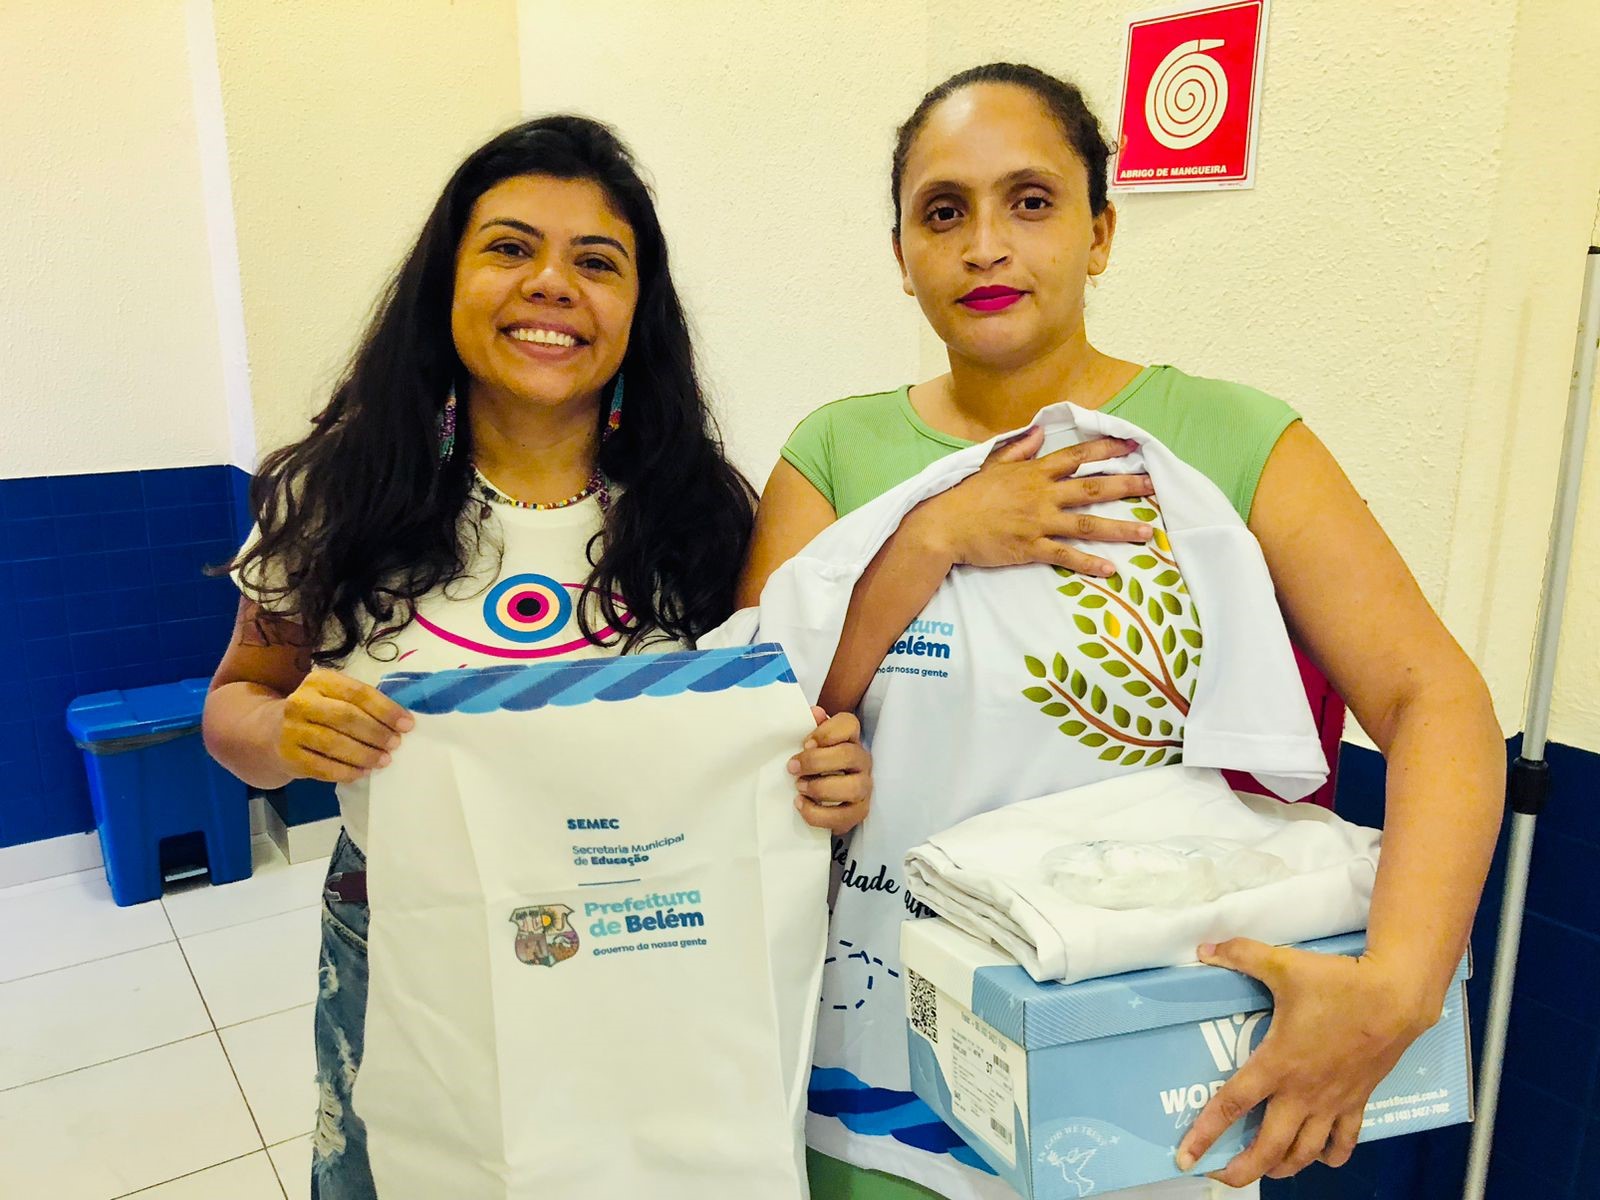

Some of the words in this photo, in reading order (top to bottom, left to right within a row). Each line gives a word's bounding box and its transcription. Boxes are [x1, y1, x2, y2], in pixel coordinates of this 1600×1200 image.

[1120, 169, 1155, 179] ABRIGO
[1156, 168, 1169, 177] DE
[1170, 165, 1228, 176] MANGUEIRA
[895, 666, 920, 675] nossa
[921, 669, 949, 679] gente
[567, 818, 620, 830] SEMEC
[572, 845, 629, 855] Secretaria
[631, 833, 685, 853] Municipal
[574, 856, 588, 866] de
[591, 853, 650, 867] Educação
[584, 890, 702, 917] Prefeitura
[589, 919, 621, 938] de
[625, 908, 705, 934] Belém
[593, 943, 635, 957] Governo
[636, 941, 650, 951] da
[651, 939, 679, 950] nossa
[680, 937, 708, 949] gente
